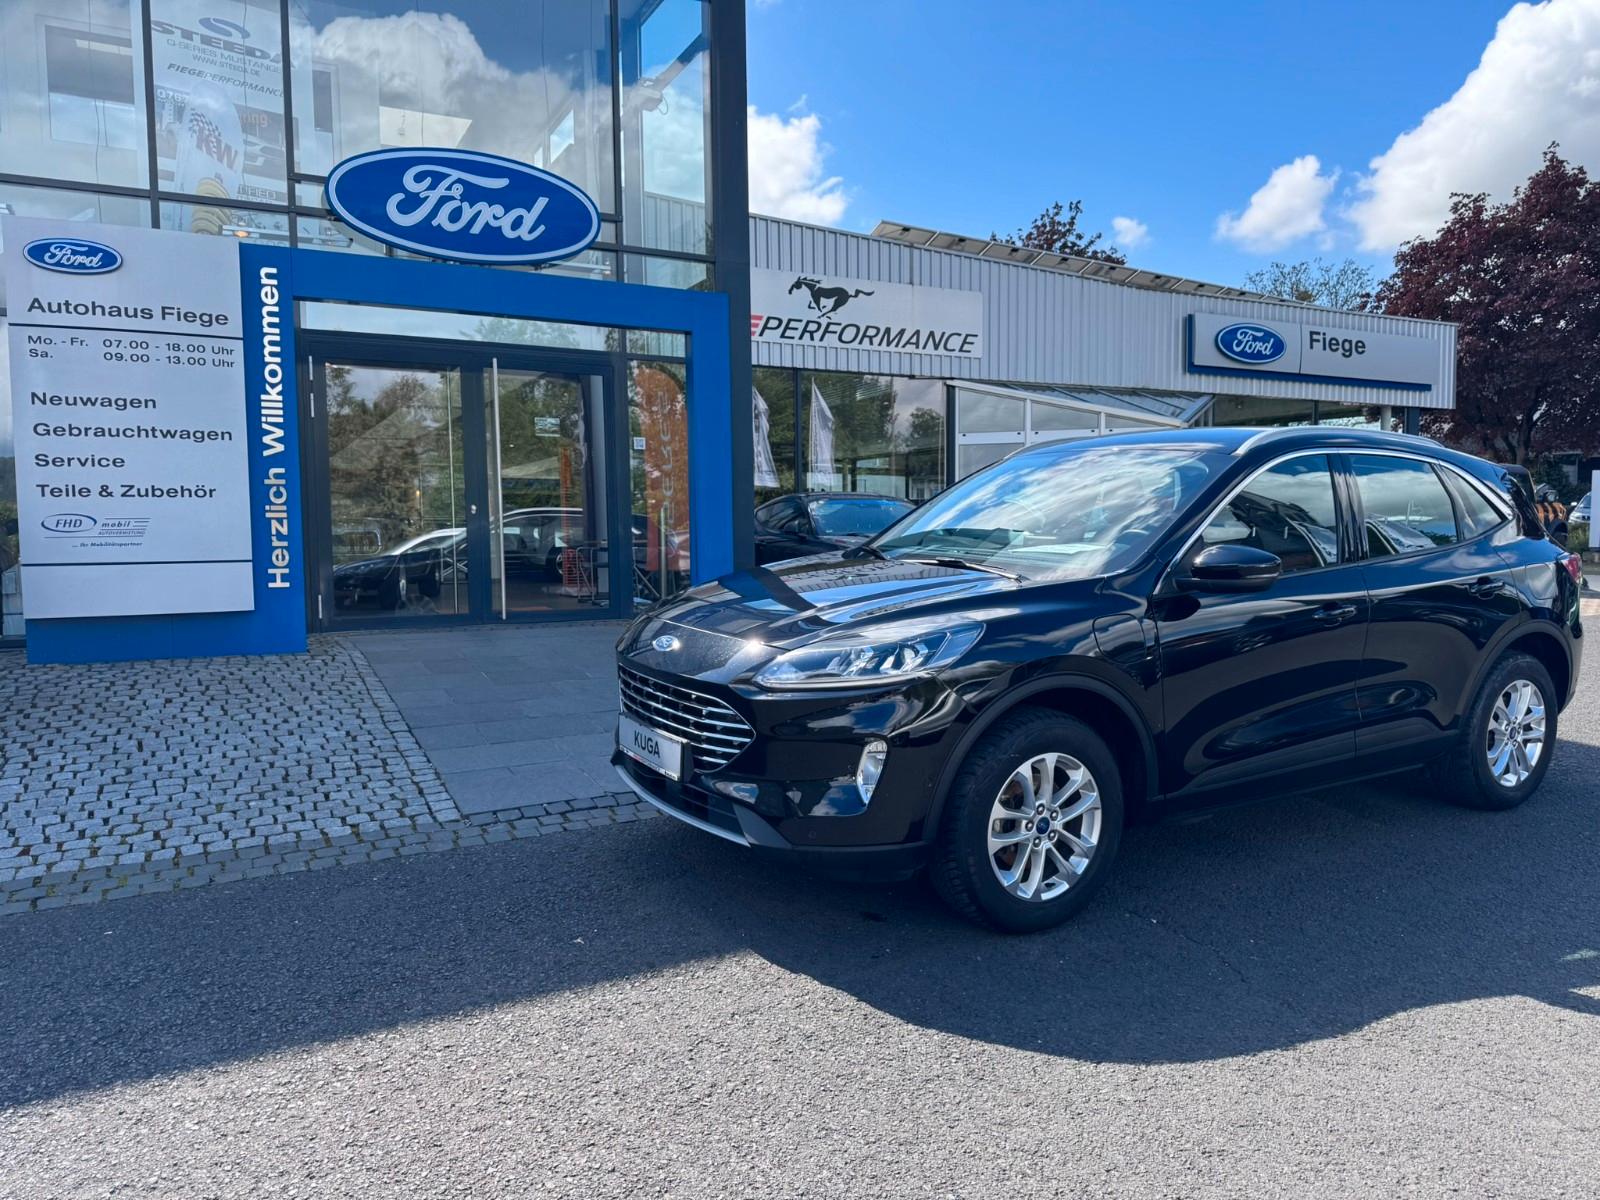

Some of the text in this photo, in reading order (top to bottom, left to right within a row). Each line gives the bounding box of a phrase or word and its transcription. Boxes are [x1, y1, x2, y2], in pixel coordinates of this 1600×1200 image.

[386, 164, 550, 242] Ford
[44, 243, 103, 268] Ford
[27, 296, 230, 327] Autohaus Fiege
[27, 334, 58, 346] Mo.
[70, 336, 89, 348] Fr.
[102, 338, 150, 351] 07.00
[165, 341, 207, 355] 18.00
[211, 344, 236, 356] Uhr
[1232, 328, 1367, 359] Ford Fiege
[29, 347, 54, 359] Sa.
[103, 351, 151, 364] 09.00
[166, 354, 207, 368] 13.00
[212, 357, 236, 369] Uhr
[30, 391, 157, 411] Neuwagen
[32, 422, 233, 443] Gebrauchtwagen
[258, 266, 291, 589] Herzlich Willkommen
[34, 453, 126, 469] Service
[36, 484, 217, 499] Teile & Zubehör
[55, 518, 132, 529] FHD mobil
[633, 729, 661, 760] KUGA
